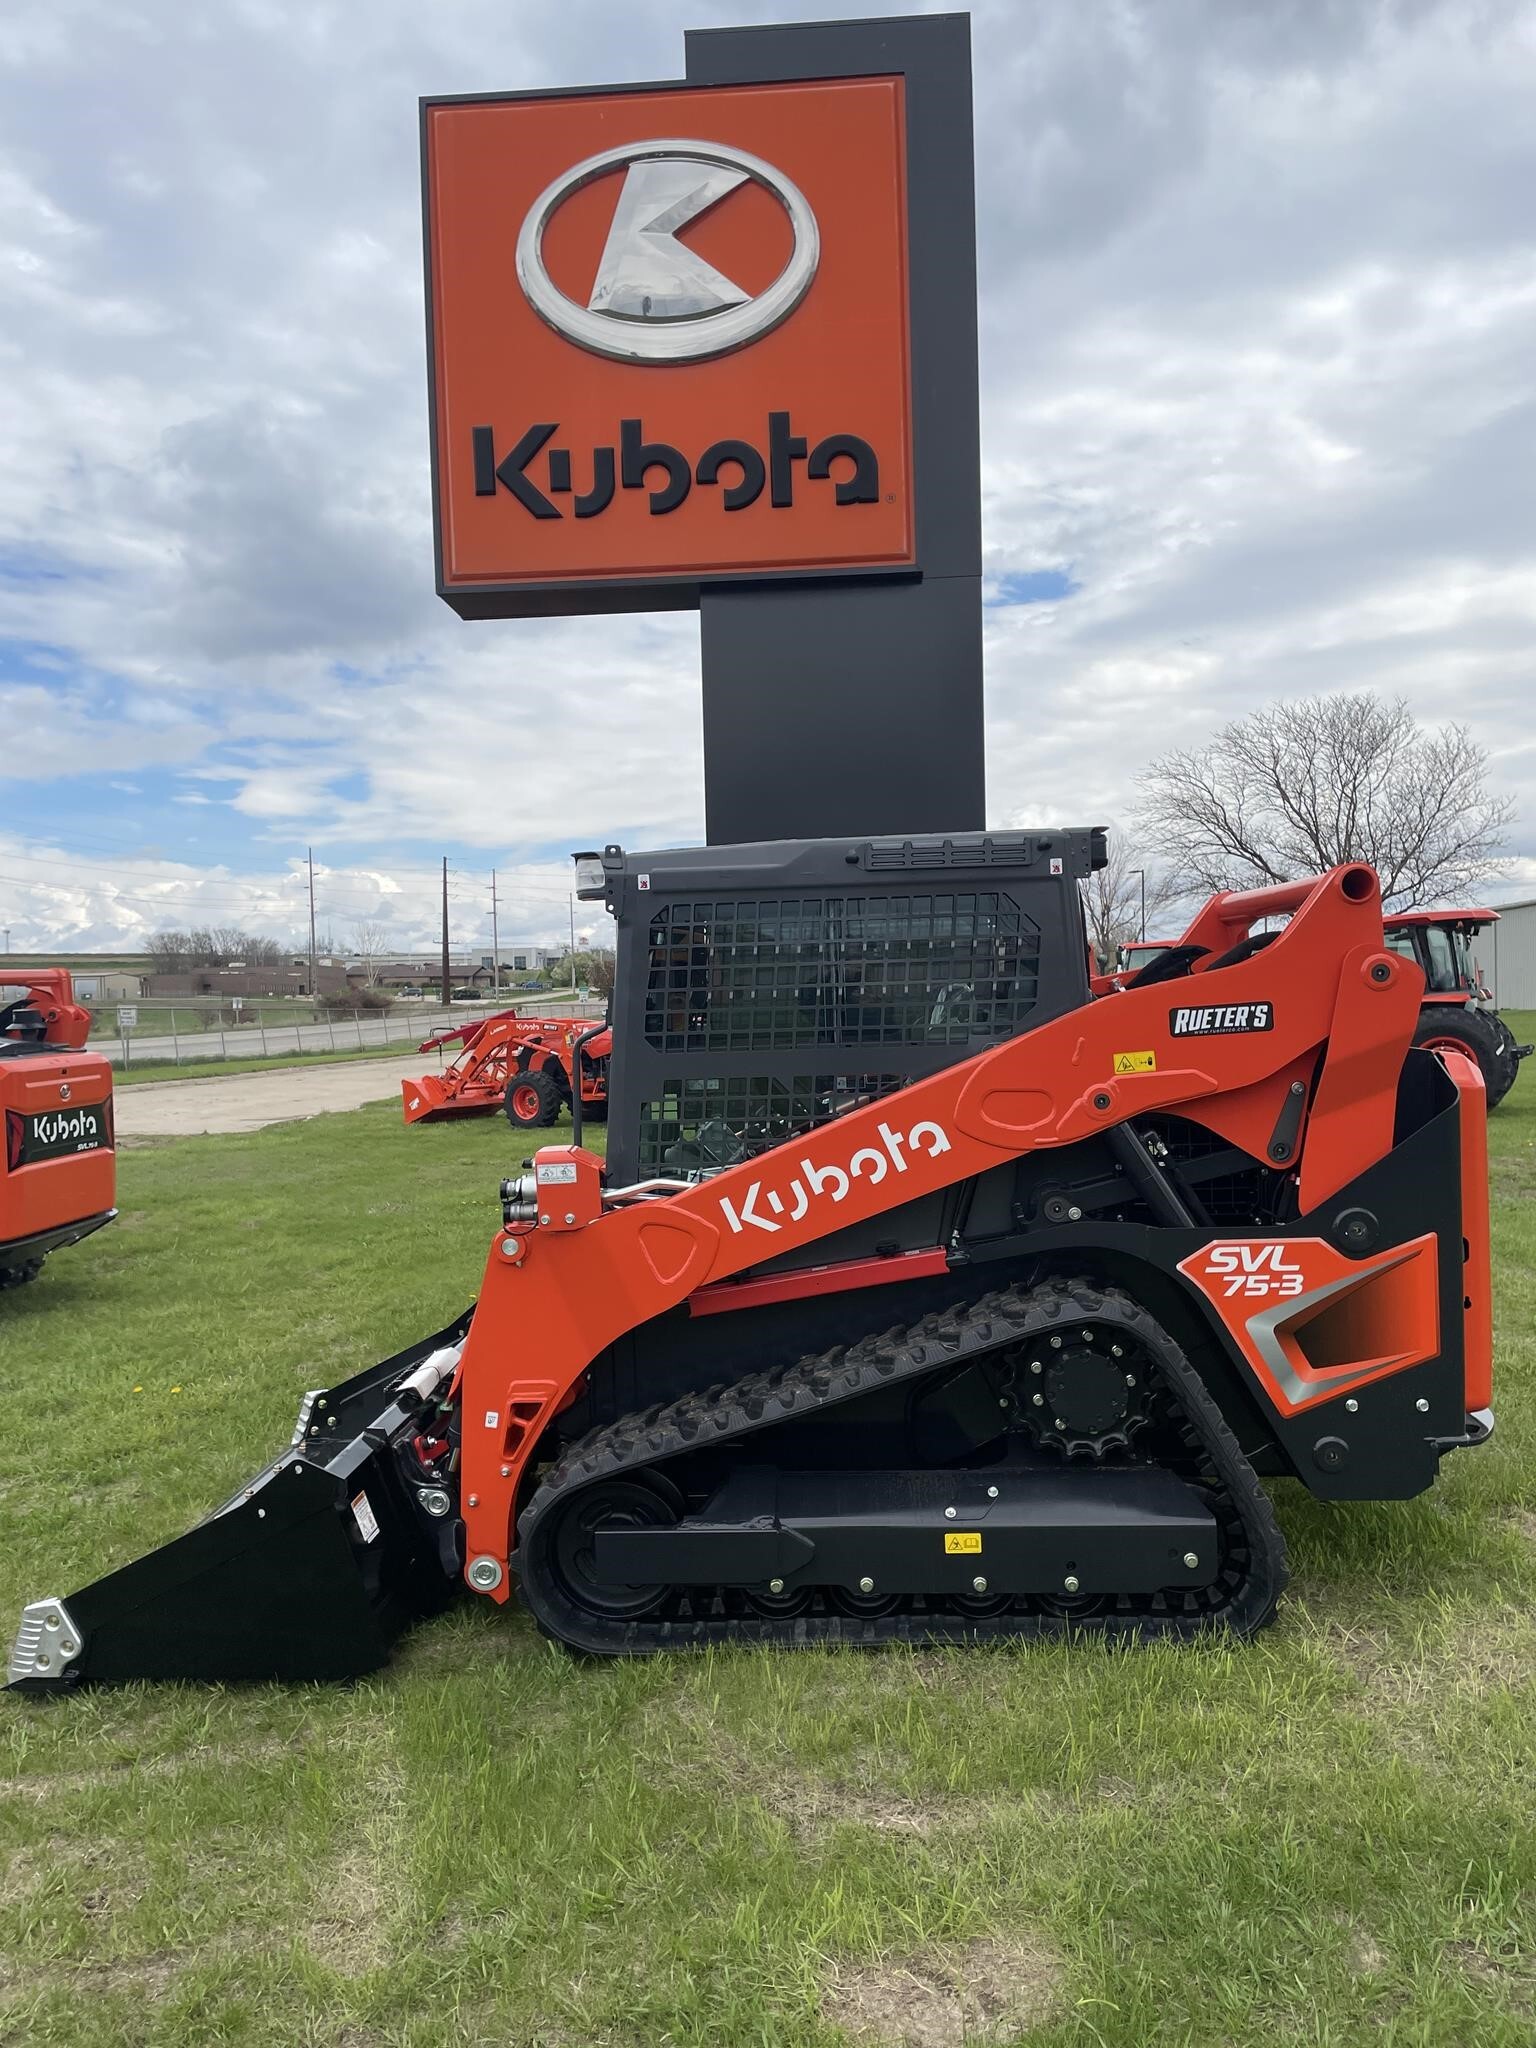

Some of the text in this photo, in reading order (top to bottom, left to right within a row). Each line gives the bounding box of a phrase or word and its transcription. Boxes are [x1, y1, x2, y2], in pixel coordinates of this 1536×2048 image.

[472, 411, 879, 519] Kubota
[1174, 1004, 1268, 1034] RUETER'S
[33, 1110, 97, 1144] Kubota
[719, 1119, 952, 1234] Kubota
[1204, 1245, 1301, 1273] SVL
[1221, 1274, 1304, 1297] 75-3
